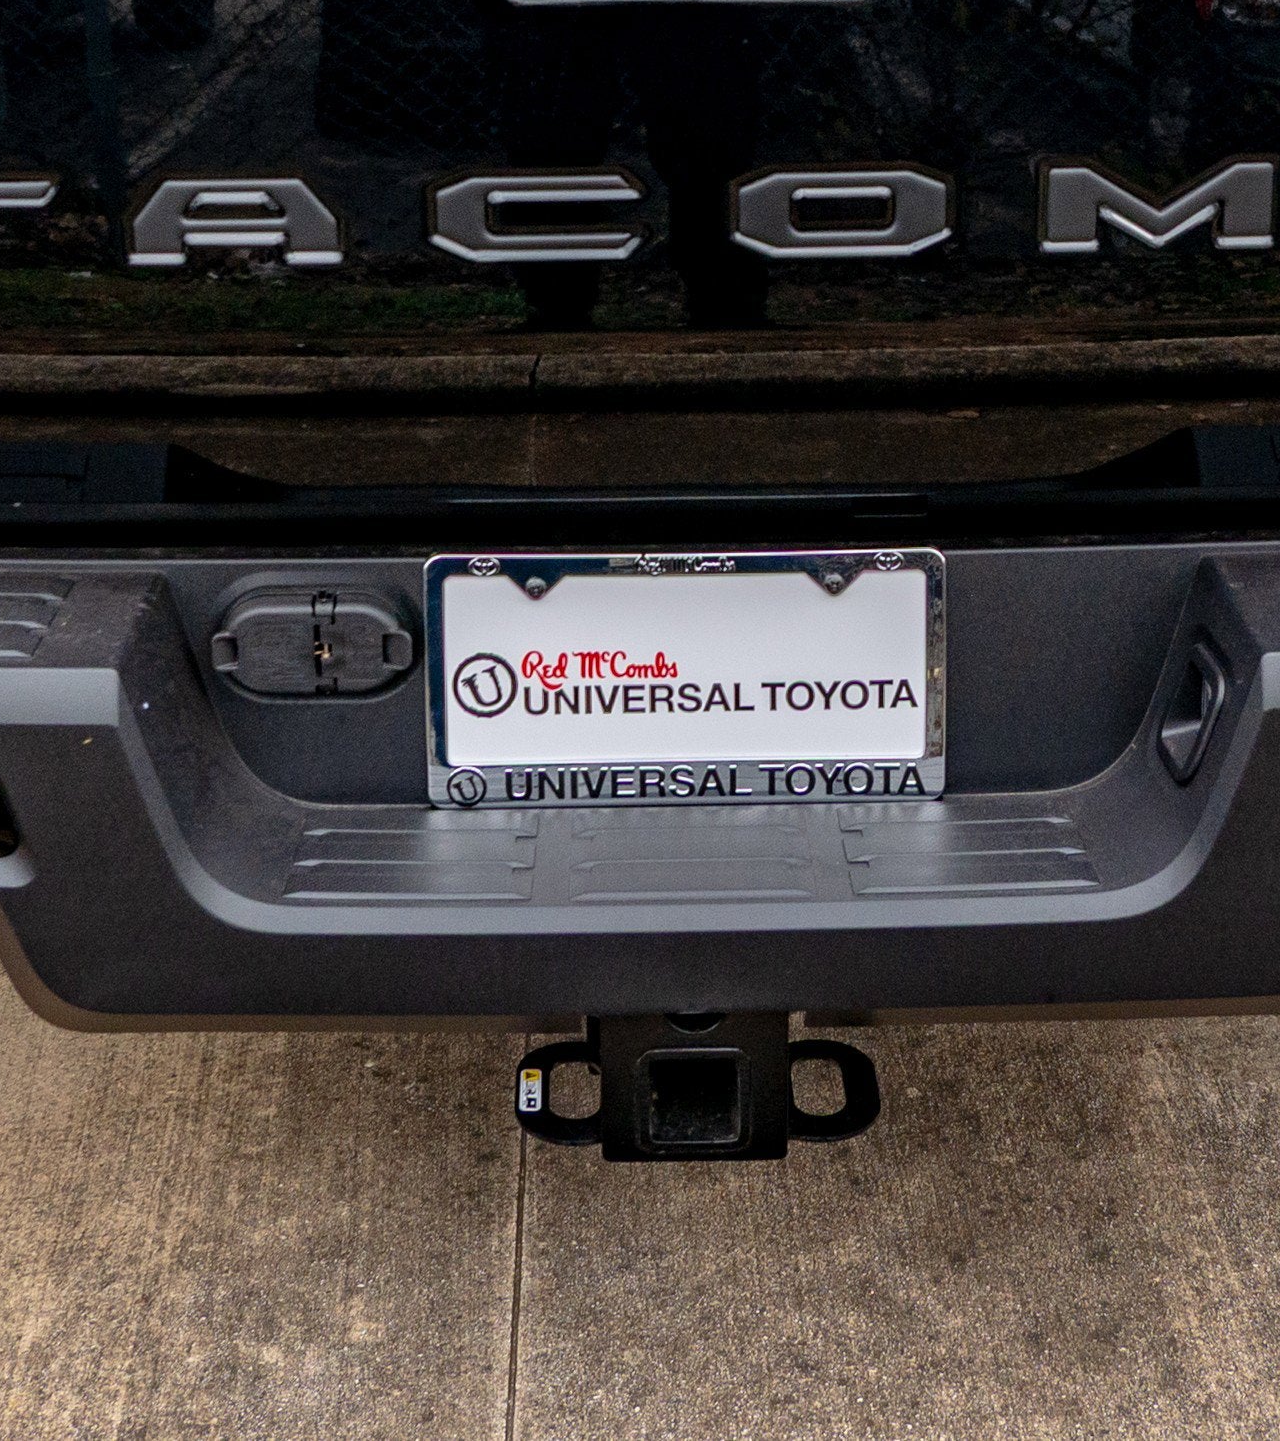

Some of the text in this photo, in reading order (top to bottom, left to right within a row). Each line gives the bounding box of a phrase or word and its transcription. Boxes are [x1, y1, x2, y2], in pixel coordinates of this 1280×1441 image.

[521, 651, 678, 690] Red McCombs
[523, 682, 755, 716] UNIVERSAL
[761, 679, 919, 712] TOYOTA
[504, 764, 754, 800] UNIVERSAL
[758, 762, 926, 796] TOYOTA
